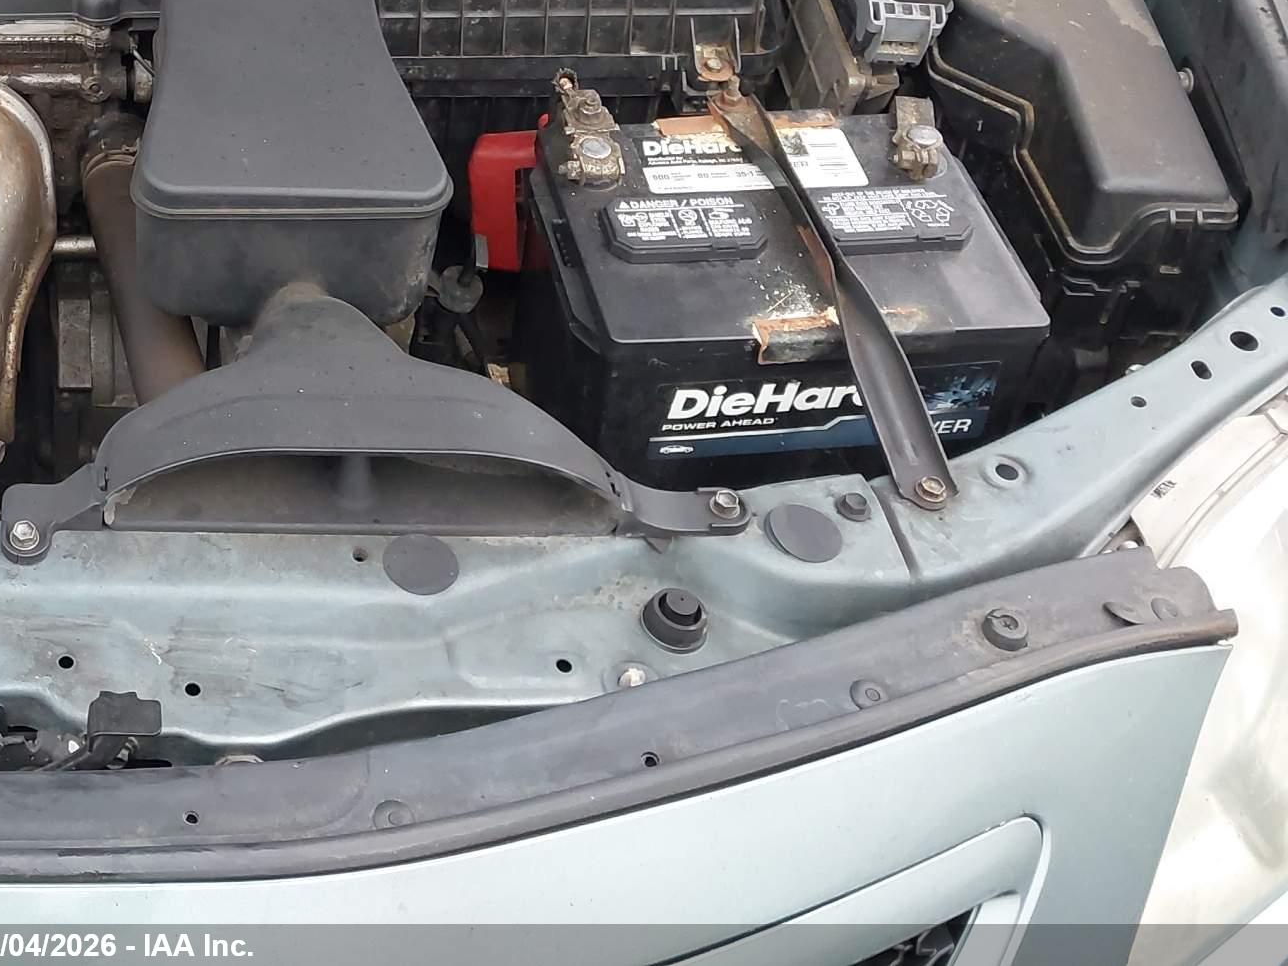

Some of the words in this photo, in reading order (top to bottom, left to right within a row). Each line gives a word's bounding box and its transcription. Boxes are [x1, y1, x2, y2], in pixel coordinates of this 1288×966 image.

[629, 199, 679, 209] DANGER
[689, 196, 734, 207] POISON
[661, 421, 717, 432] POWER
[720, 417, 776, 428] AHEAD
